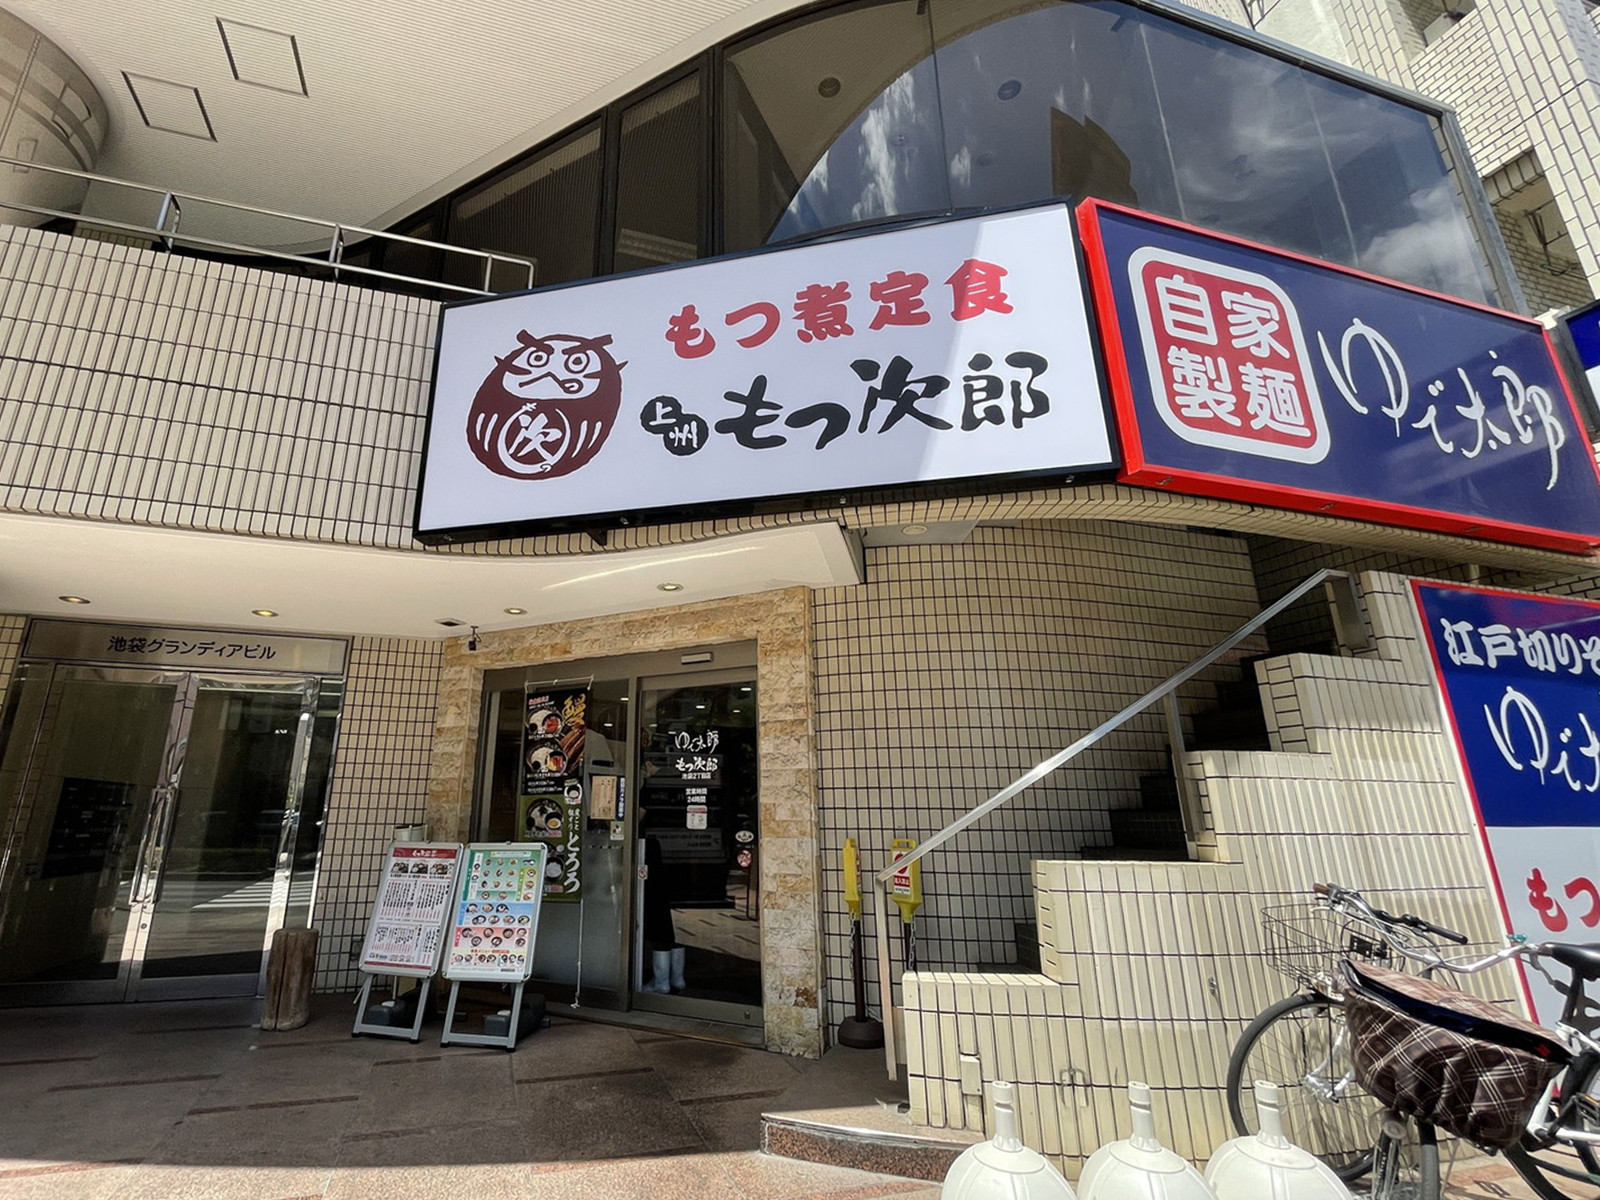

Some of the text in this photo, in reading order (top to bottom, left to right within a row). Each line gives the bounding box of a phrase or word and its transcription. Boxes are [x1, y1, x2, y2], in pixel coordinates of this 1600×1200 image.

[666, 259, 1014, 359] もつ煮定食
[1155, 274, 1291, 360] 自家
[648, 350, 1050, 451] 上州 もつ次郎
[1166, 344, 1312, 438] 製麺
[1316, 317, 1566, 491] ゆで太郎
[107, 635, 277, 660] 池袋グランディアビル
[674, 729, 720, 755] ゆで太郎
[675, 756, 718, 772] もつ次郎
[563, 831, 581, 894] とろろ
[1526, 868, 1600, 932] もつ
